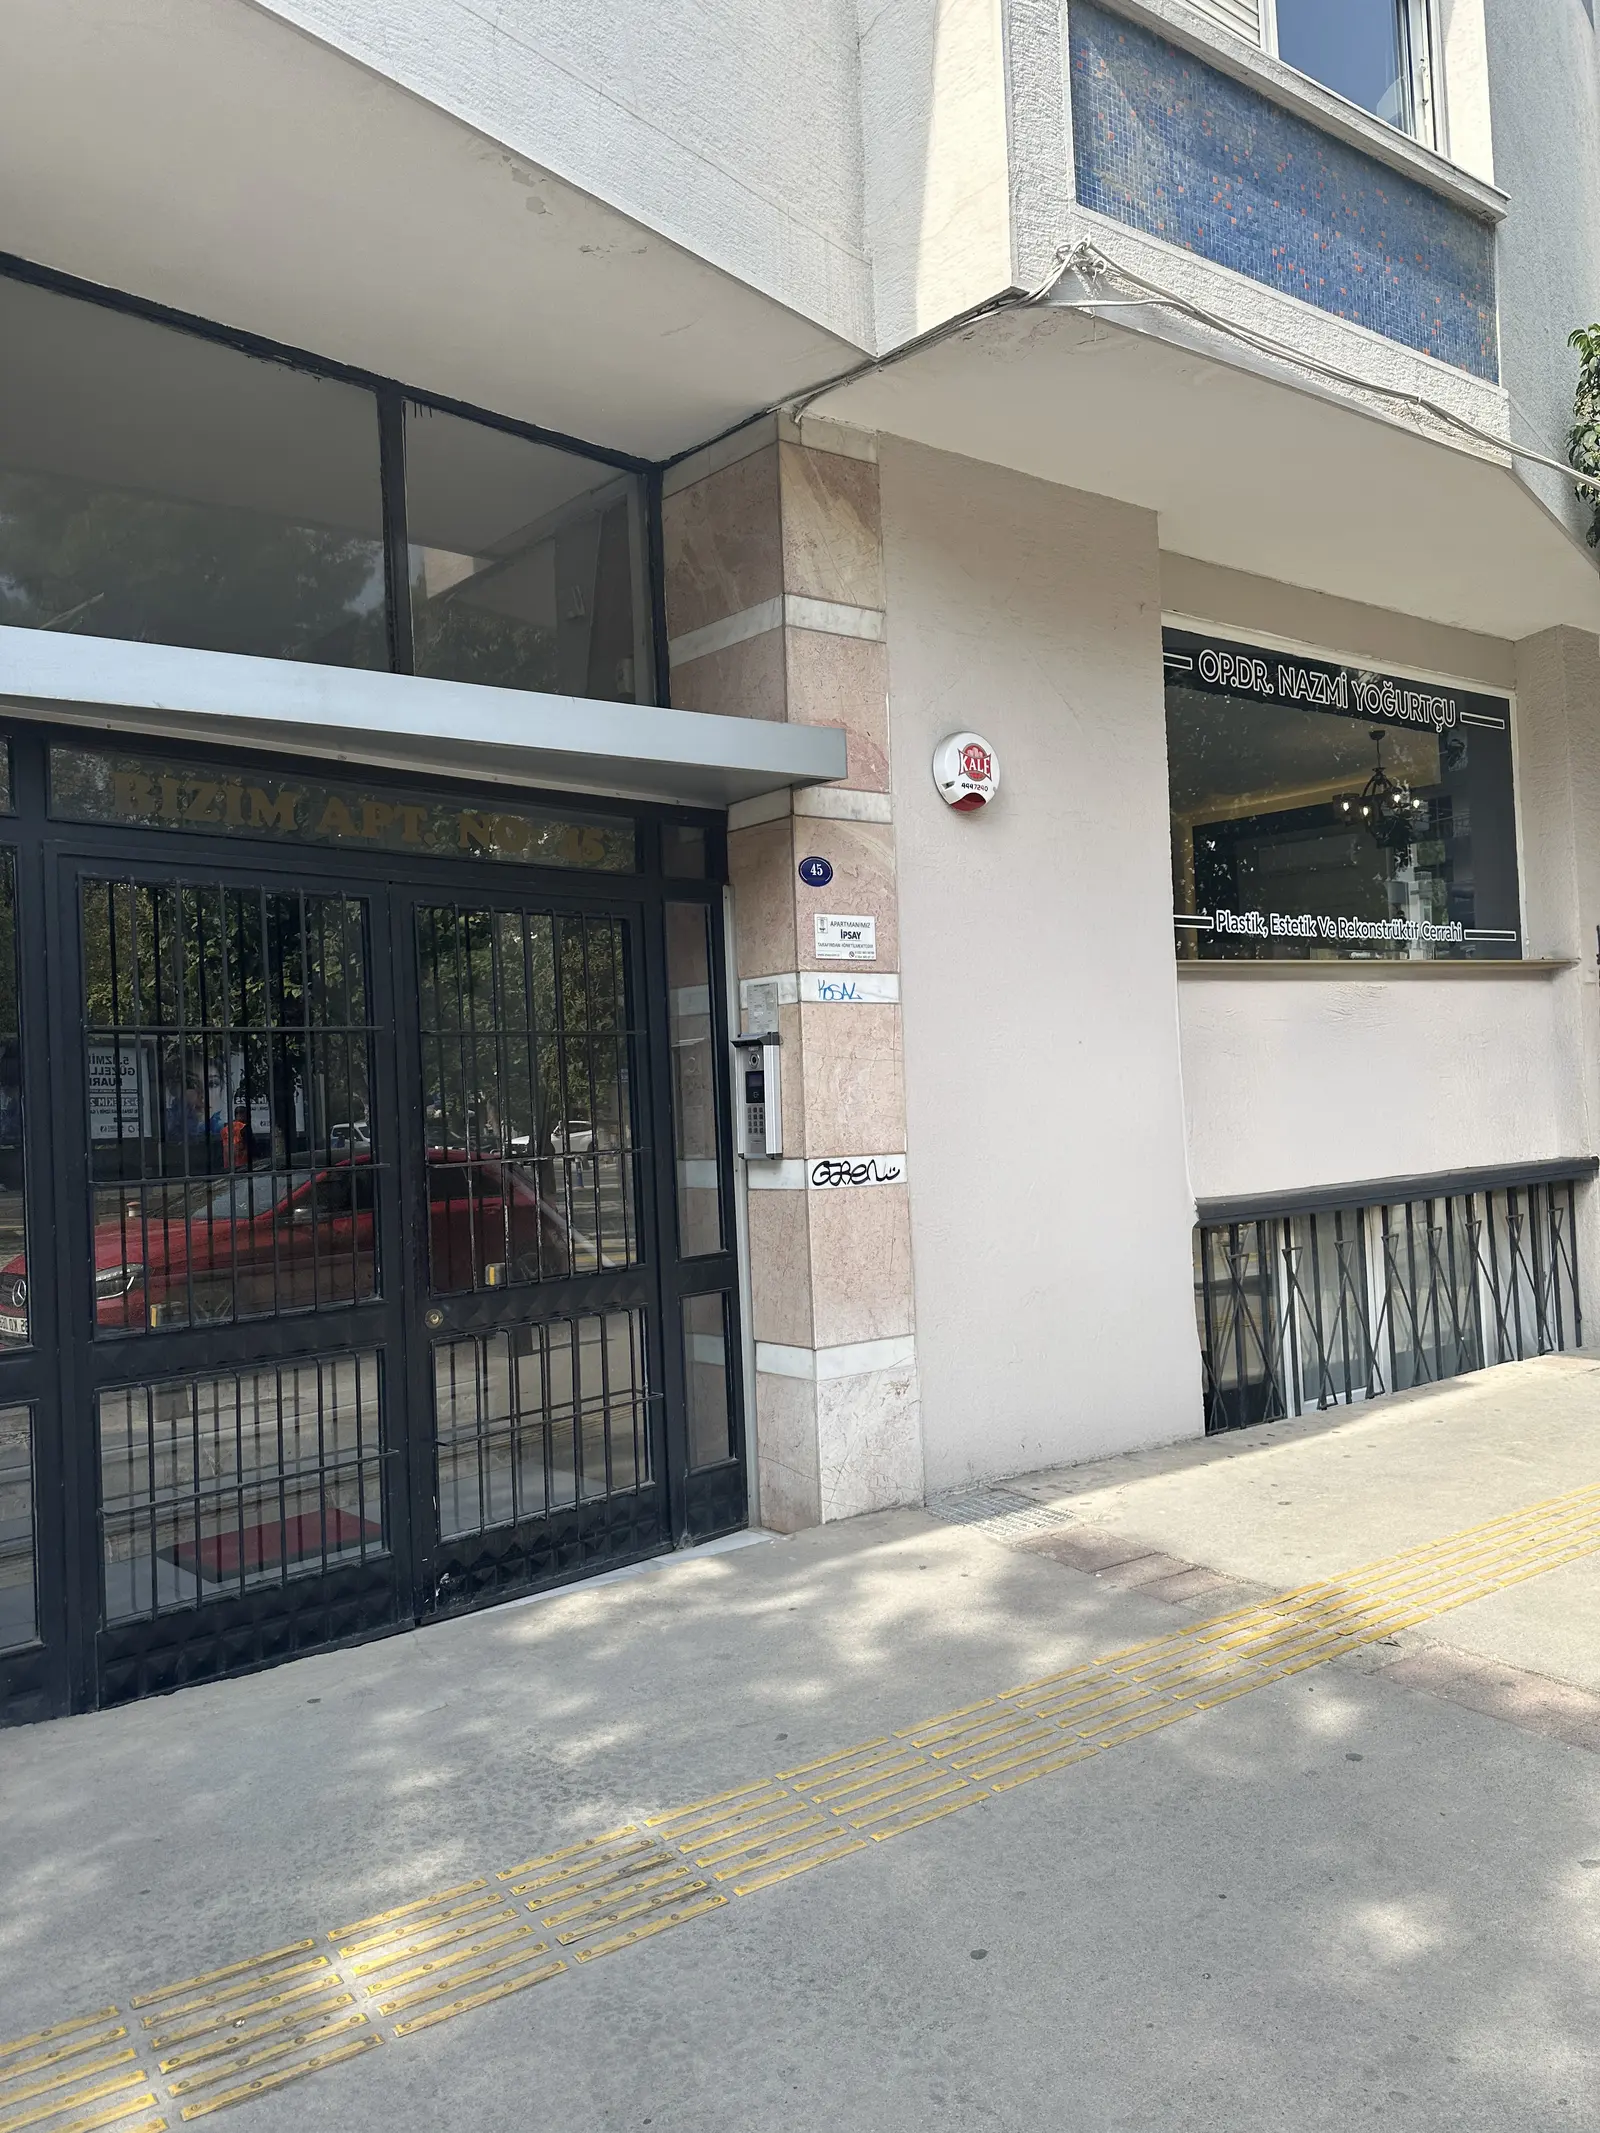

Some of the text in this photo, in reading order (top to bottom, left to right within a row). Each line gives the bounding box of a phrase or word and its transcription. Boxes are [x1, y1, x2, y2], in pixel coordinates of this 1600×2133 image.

[1199, 648, 1456, 733] OP.DR. NAZMİ YOĞURTÇU
[959, 753, 991, 777] KALE
[315, 794, 438, 848] APT.
[810, 863, 824, 876] 45
[840, 928, 862, 940] İPSAY
[1216, 909, 1463, 942] Plastik, Estetik Ve Rekonstrüktif Cerrahi
